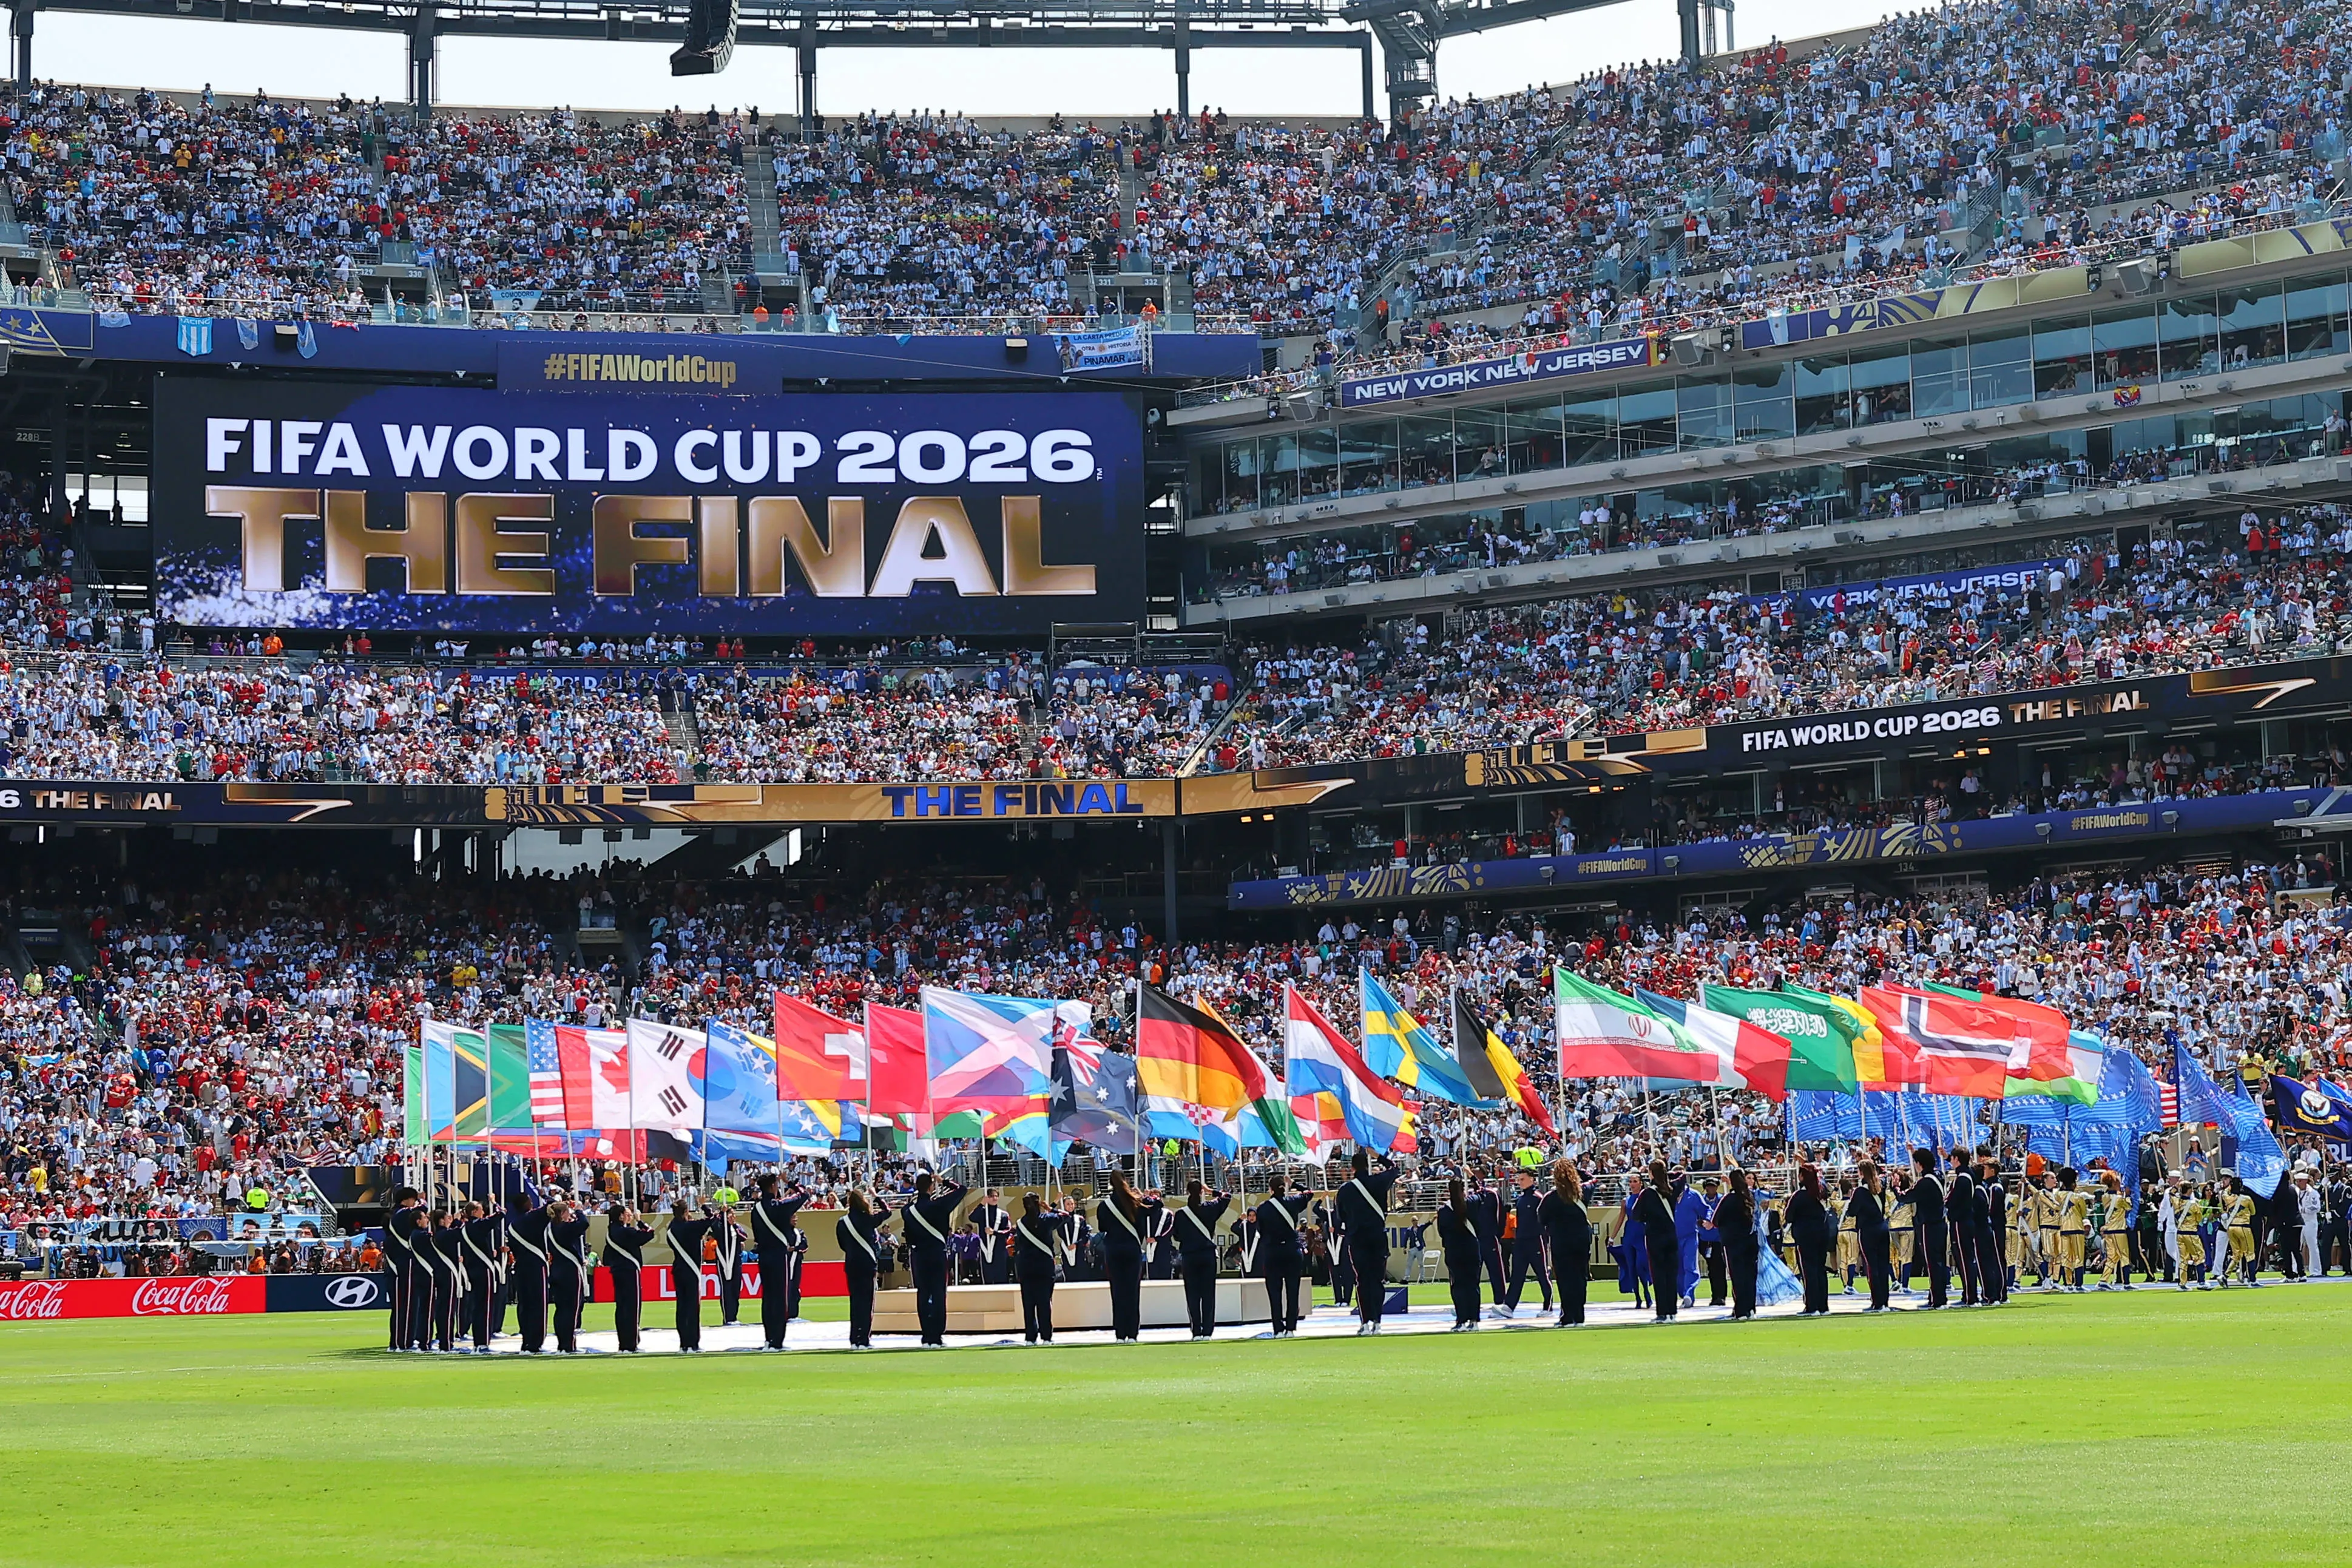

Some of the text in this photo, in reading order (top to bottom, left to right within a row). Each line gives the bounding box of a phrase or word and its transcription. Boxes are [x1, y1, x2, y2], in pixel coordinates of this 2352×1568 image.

[544, 353, 736, 388] #FIFAWorldCup
[1084, 354, 1126, 365] PINAMAR
[1355, 344, 1644, 400] NEW YORK NEW JERSEY
[17, 433, 39, 442] 228B
[206, 417, 370, 477] FIFA
[382, 424, 658, 482] WORLD
[674, 428, 822, 483] CUP
[836, 429, 1095, 483] 2026
[206, 484, 1097, 597] THE FINAL
[1950, 568, 2055, 593] JERSE
[1742, 690, 2149, 752] FIFA WORLD CUP 2026 THE FINAL
[30, 790, 89, 809] THE
[94, 791, 181, 810] FINAL
[882, 783, 1143, 817] THE FINAL
[2071, 811, 2149, 831] #FIFAWorldCup
[1578, 857, 1647, 874] #FIFAWorldCup
[1899, 863, 1914, 872] 134
[155, 1064, 165, 1073] 10
[0, 1282, 69, 1319] a-Cola
[132, 1277, 235, 1315] Coca-Cola
